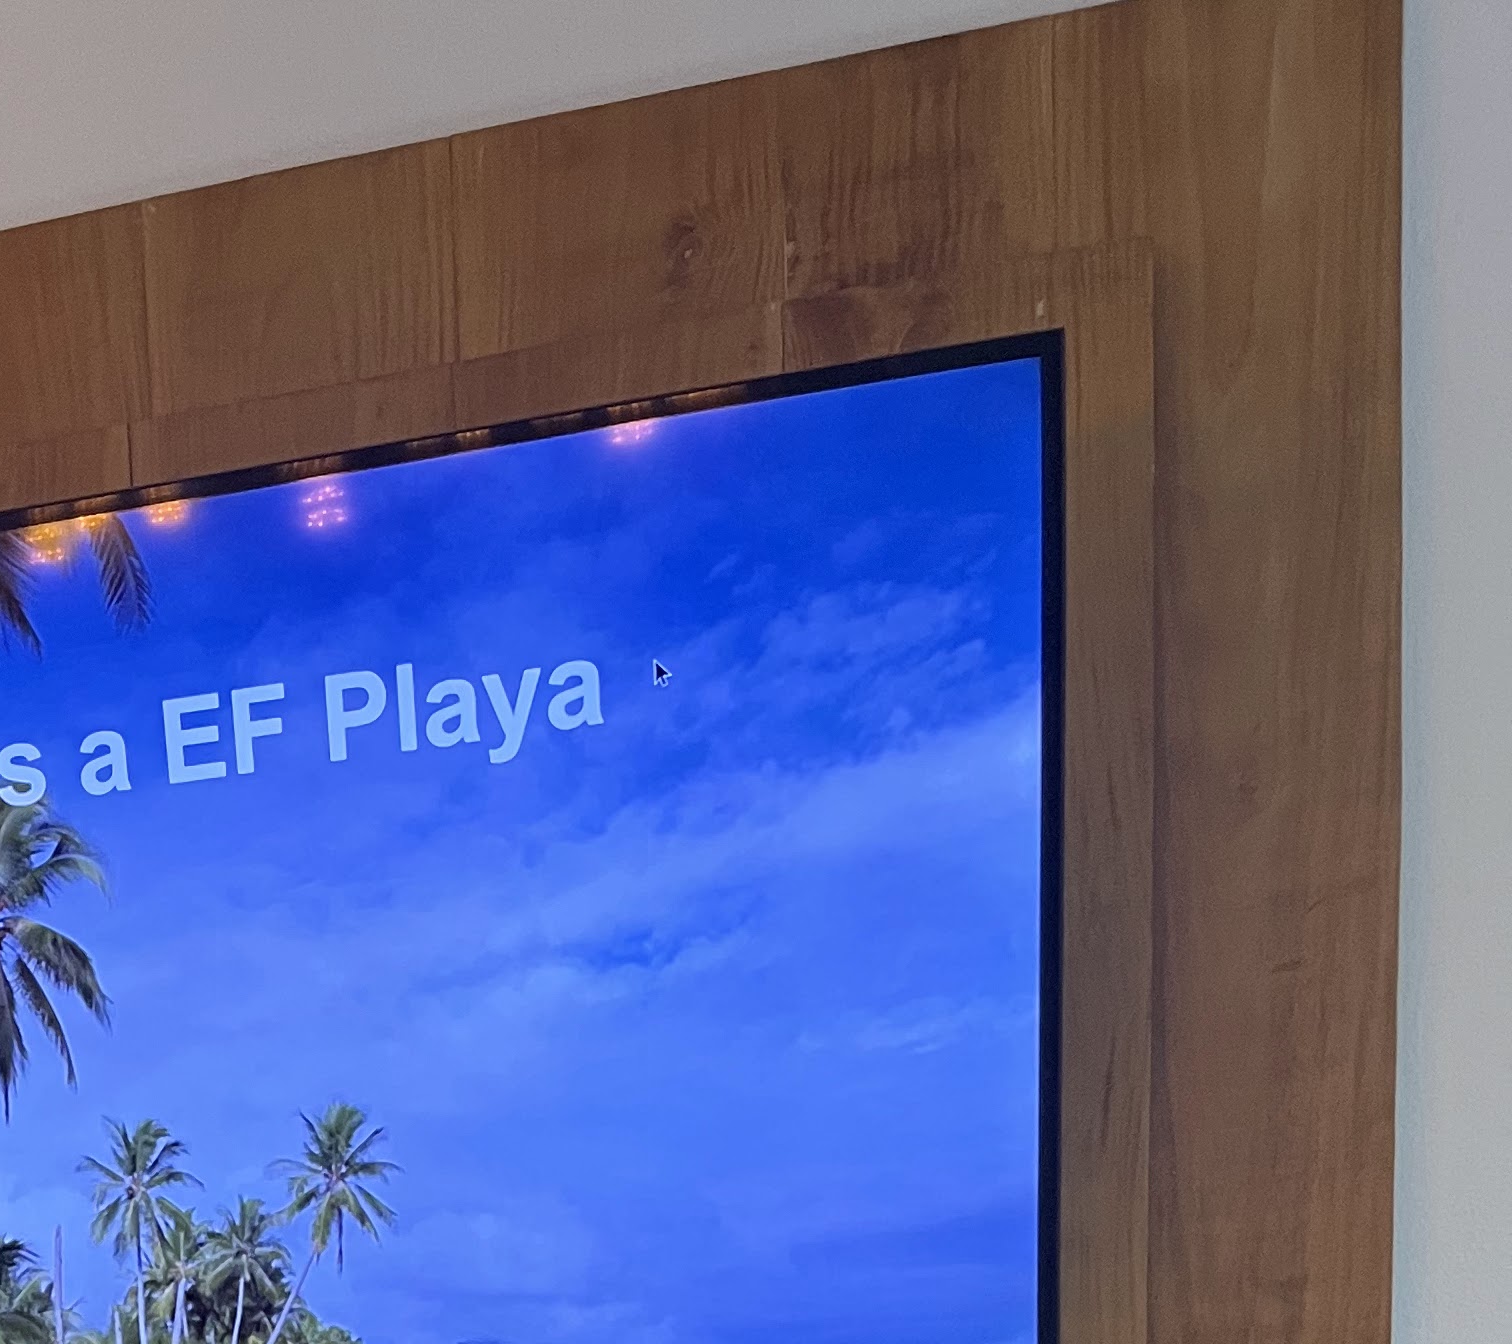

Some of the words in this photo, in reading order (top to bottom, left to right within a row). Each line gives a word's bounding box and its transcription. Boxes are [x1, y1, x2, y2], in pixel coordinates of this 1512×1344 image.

[80, 730, 132, 797] a
[162, 682, 285, 785] EF
[325, 658, 605, 765] Playa
